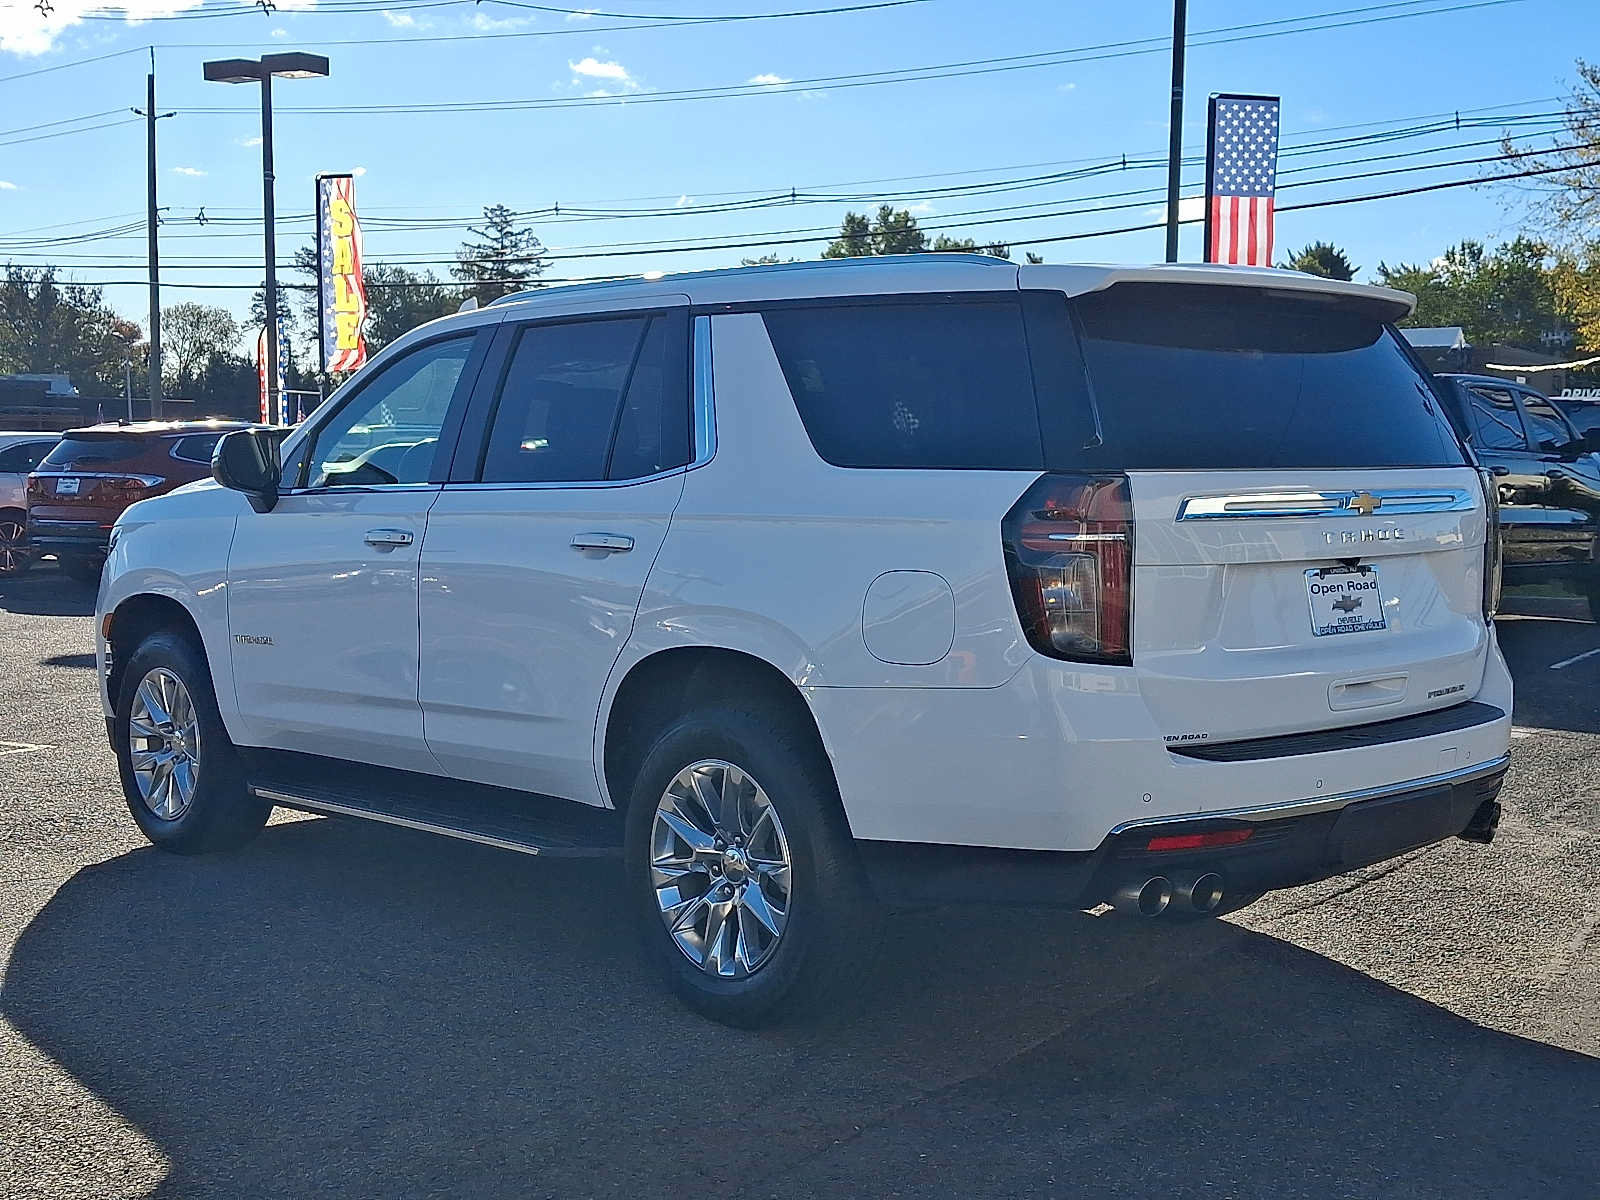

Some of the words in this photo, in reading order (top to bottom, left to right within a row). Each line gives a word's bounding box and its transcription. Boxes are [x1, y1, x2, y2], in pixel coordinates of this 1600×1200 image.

[330, 199, 359, 350] SALE
[1311, 583, 1344, 596] Open
[1347, 579, 1377, 591] Road
[1180, 733, 1208, 741] ROAD
